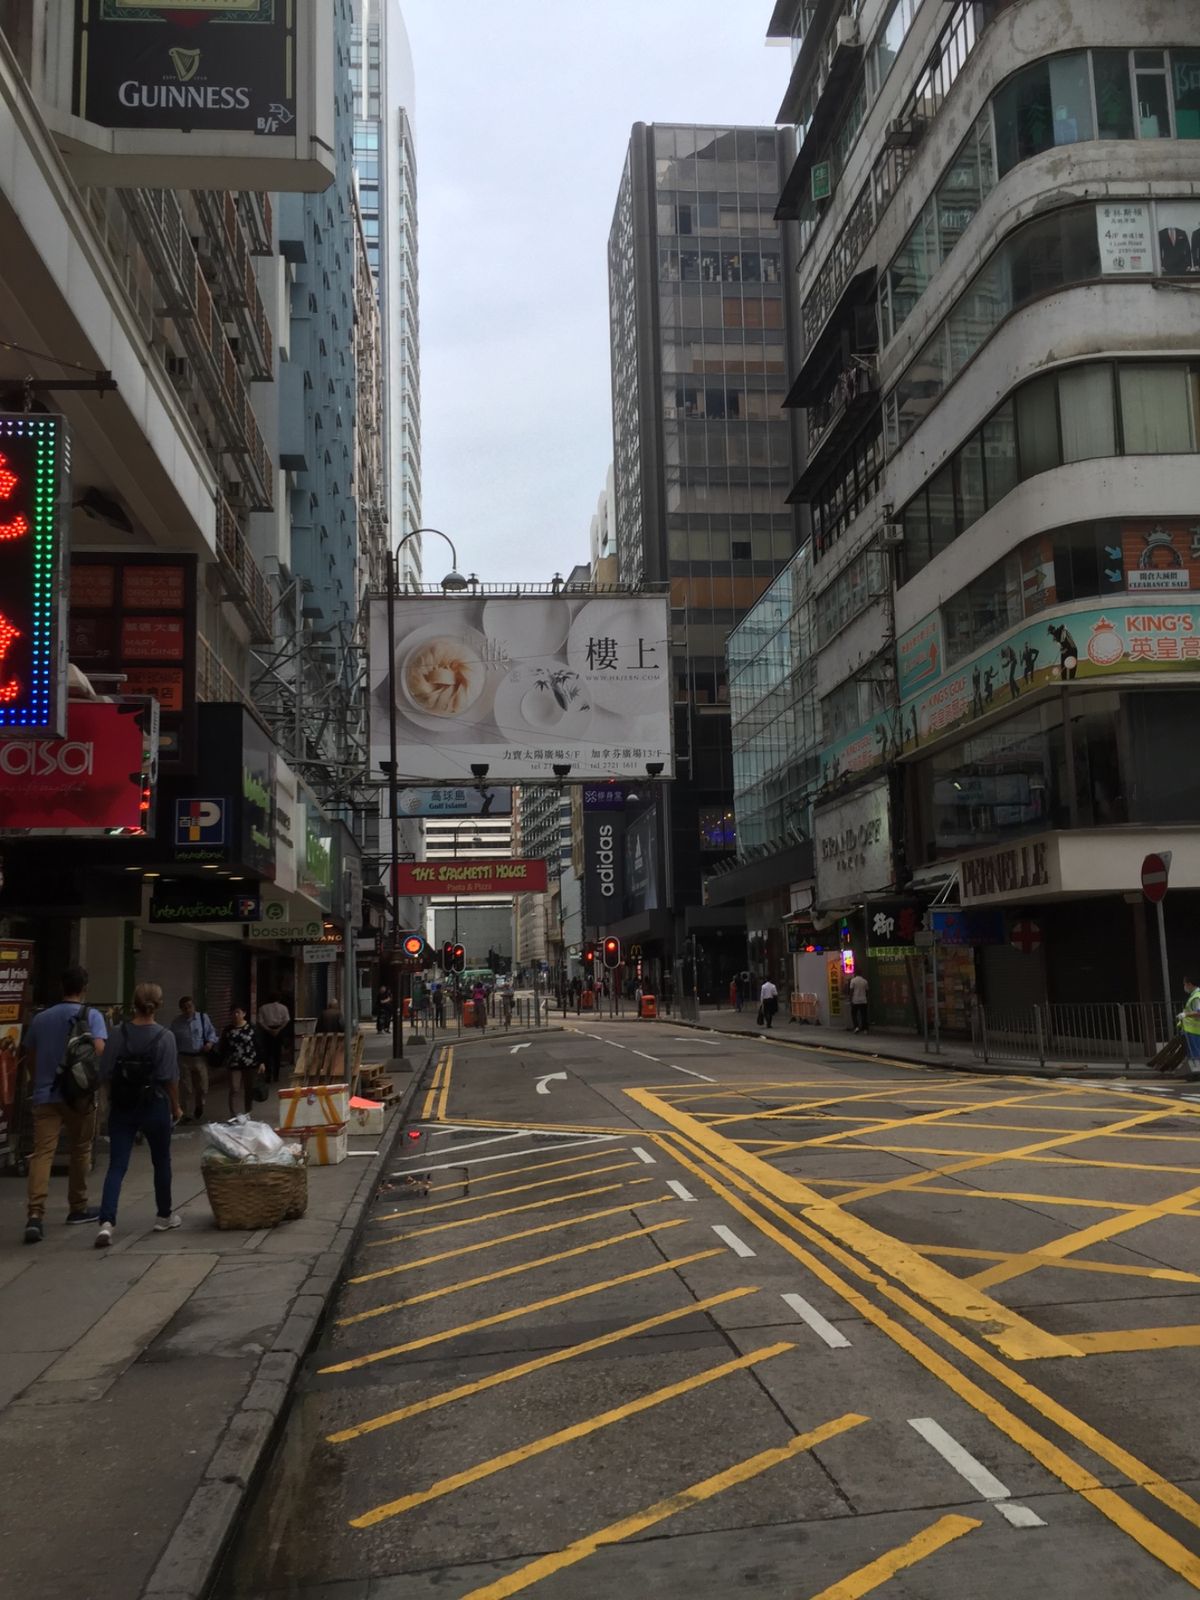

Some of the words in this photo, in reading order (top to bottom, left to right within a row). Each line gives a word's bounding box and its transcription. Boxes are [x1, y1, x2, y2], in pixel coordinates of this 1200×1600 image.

[118, 80, 250, 109] GUINNESS
[256, 117, 279, 133] B/F
[1127, 616, 1193, 631] KING'S
[124, 648, 180, 656] BUILDING
[586, 637, 659, 671] 樓上
[596, 825, 615, 896] adidas
[410, 867, 435, 881] THE
[438, 865, 492, 881] SPAGHETTI
[496, 864, 527, 878] HOUSE
[252, 924, 303, 937] bossini
